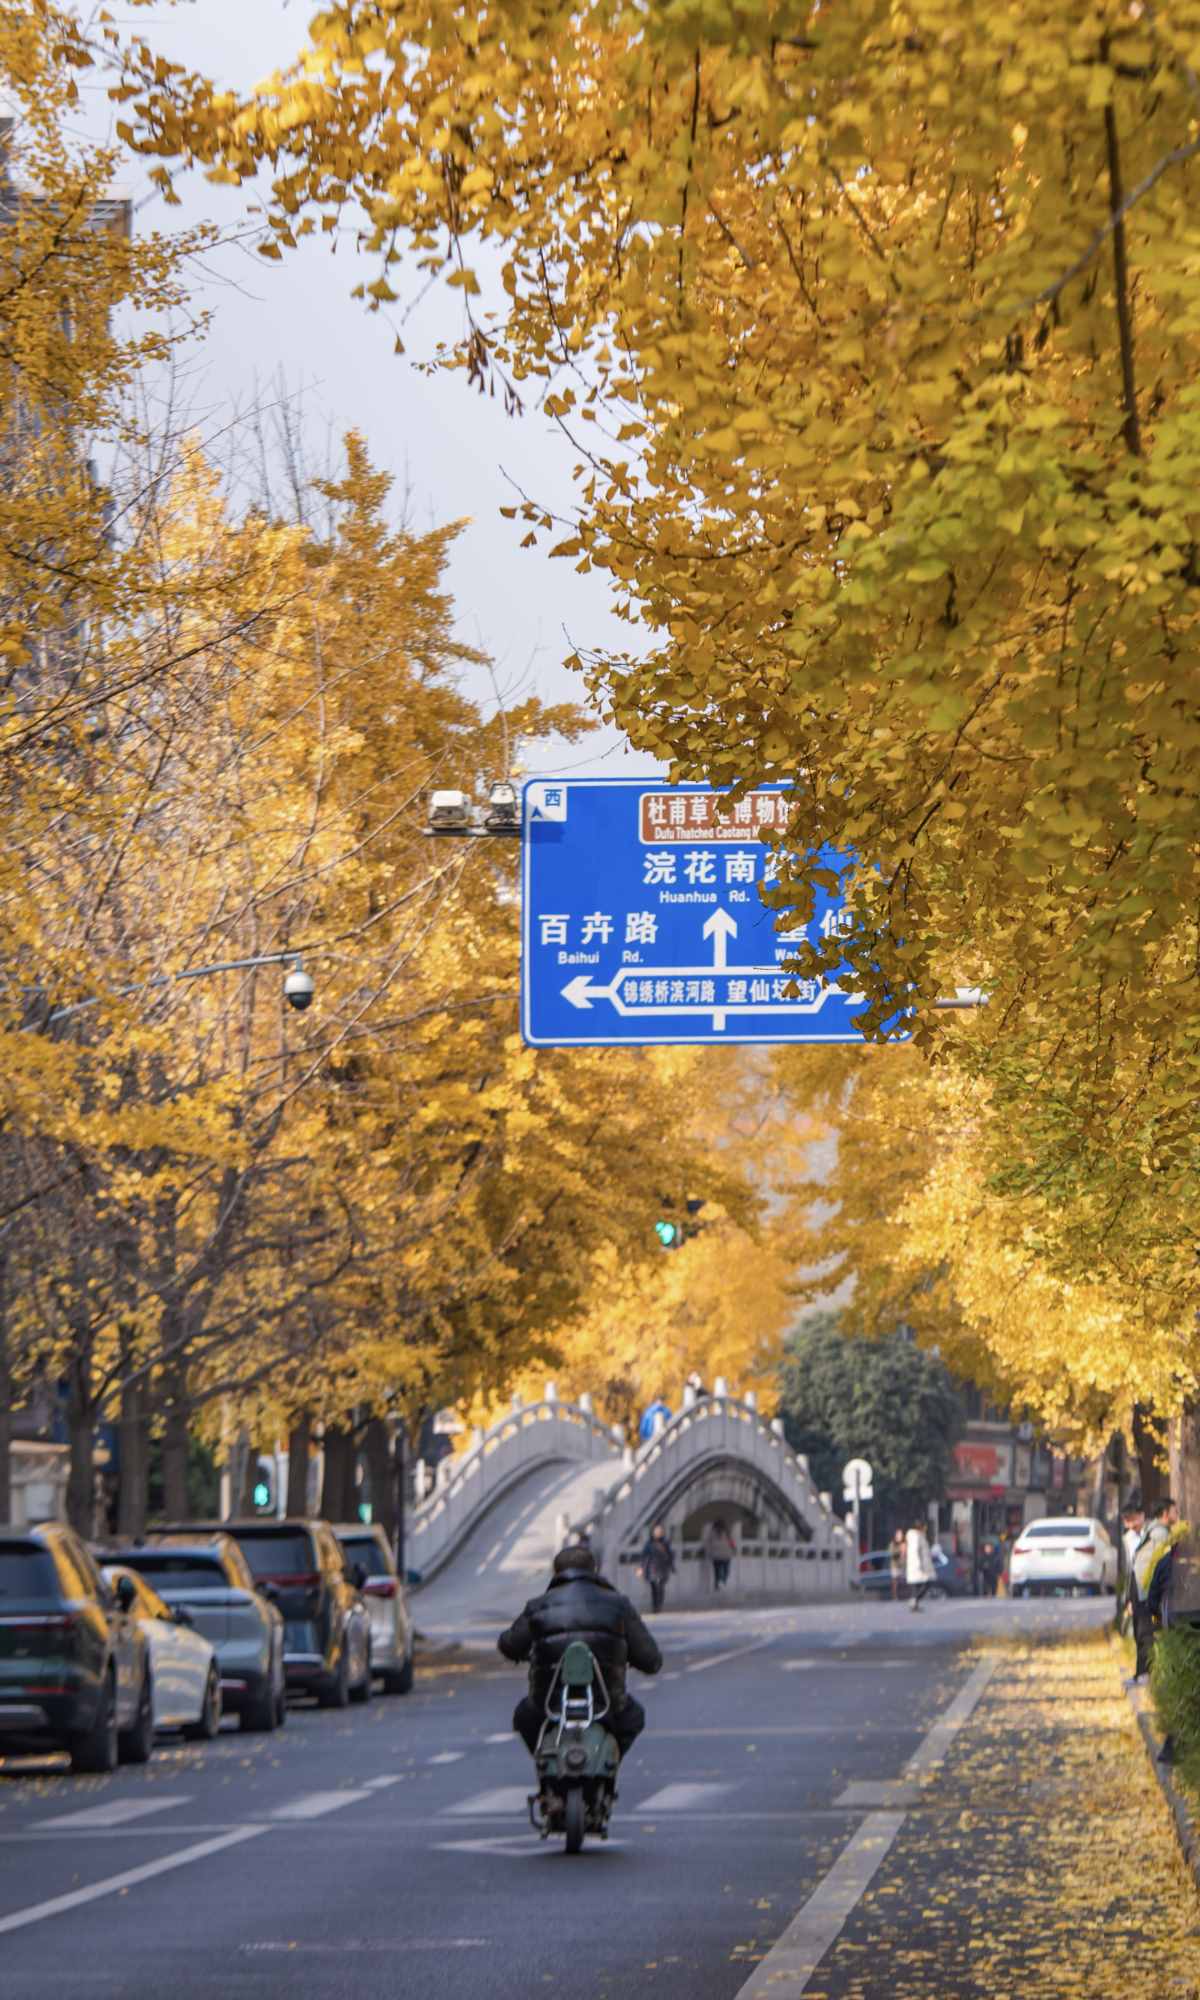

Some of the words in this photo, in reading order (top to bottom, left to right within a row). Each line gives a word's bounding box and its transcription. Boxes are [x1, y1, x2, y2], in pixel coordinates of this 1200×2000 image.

[544, 788, 564, 808] 西
[654, 827, 675, 840] Dufu
[676, 825, 714, 839] Thatched
[660, 890, 718, 904] Huanhua
[729, 889, 751, 903] Rd.
[538, 911, 660, 946] 百卉路
[558, 951, 600, 965] Baihui
[622, 950, 645, 964] Rd.
[623, 979, 716, 1005] 锦绣桥滨河路
